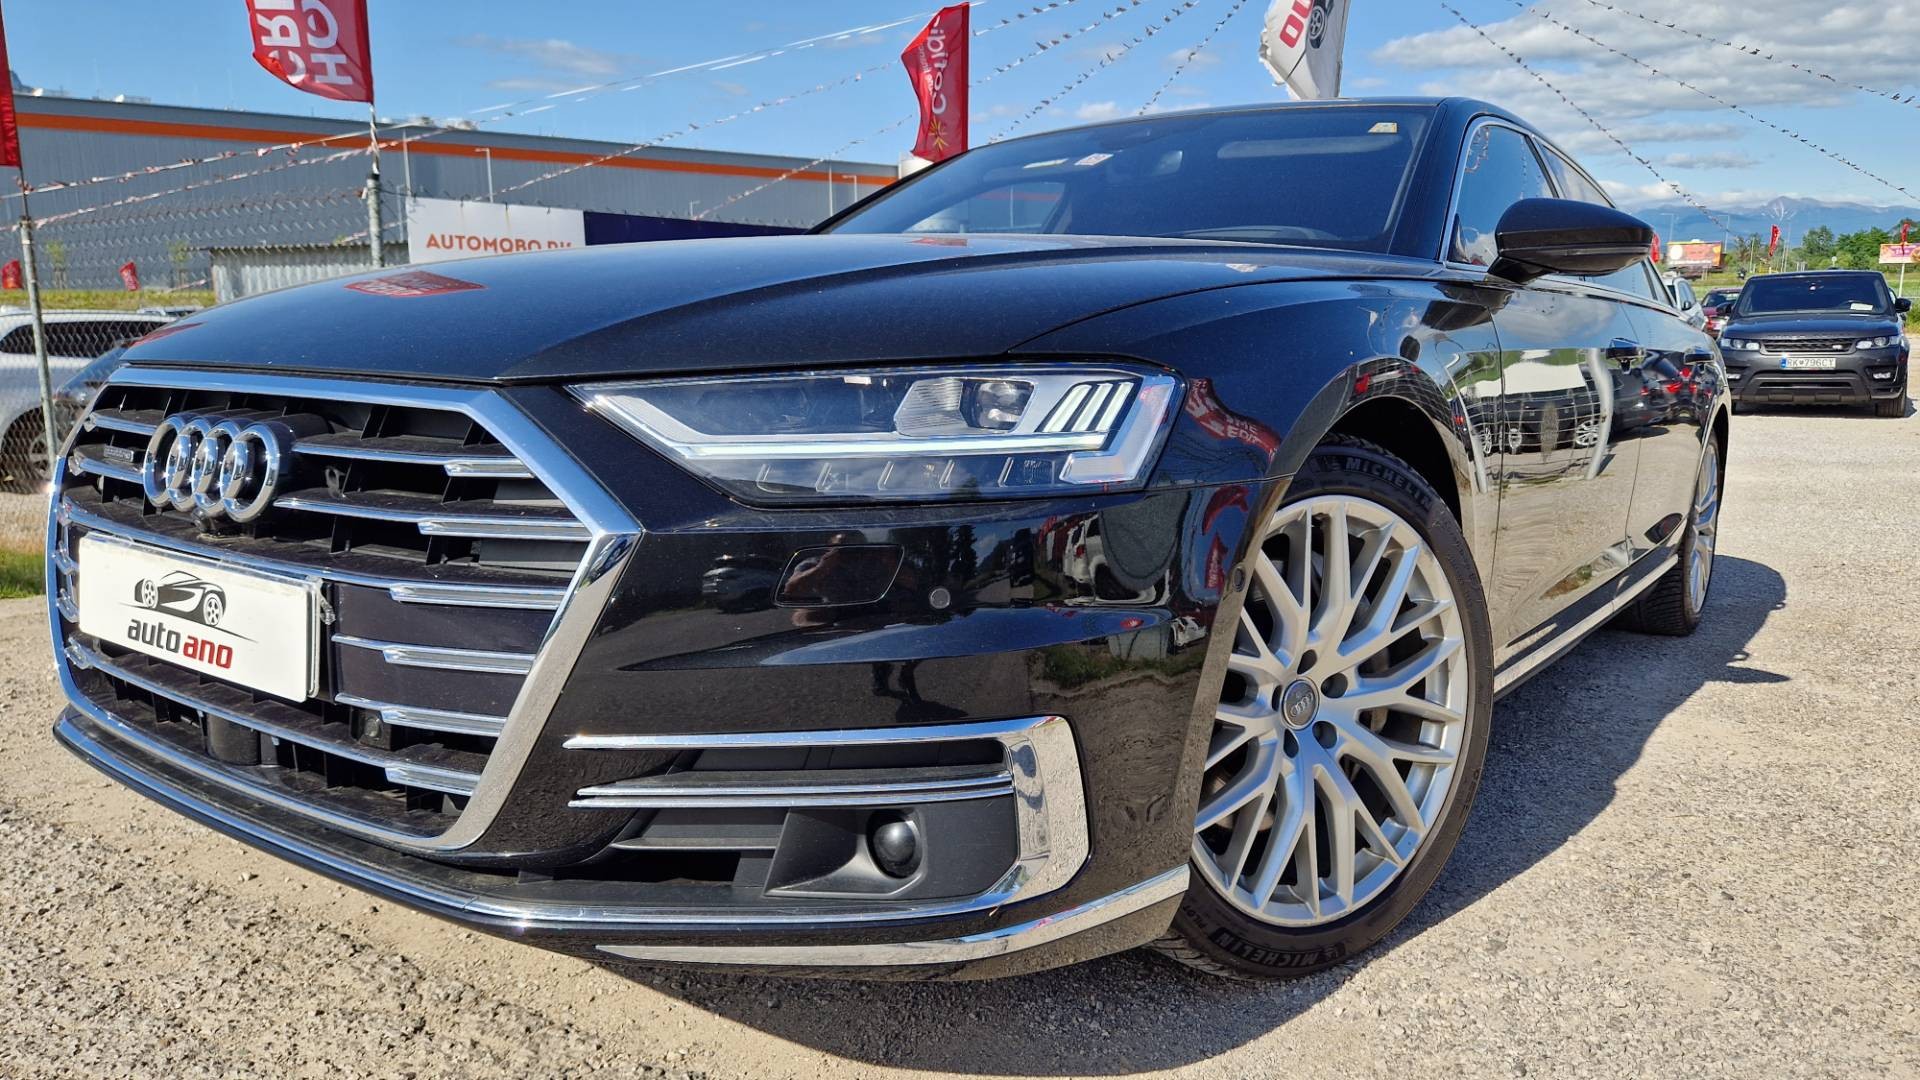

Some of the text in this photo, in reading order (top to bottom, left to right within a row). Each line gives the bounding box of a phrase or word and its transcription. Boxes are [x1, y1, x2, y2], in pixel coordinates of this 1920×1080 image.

[1345, 457, 1433, 511] MICHELIN
[127, 618, 233, 670] auto ano
[1214, 930, 1320, 968] MICHELIN
